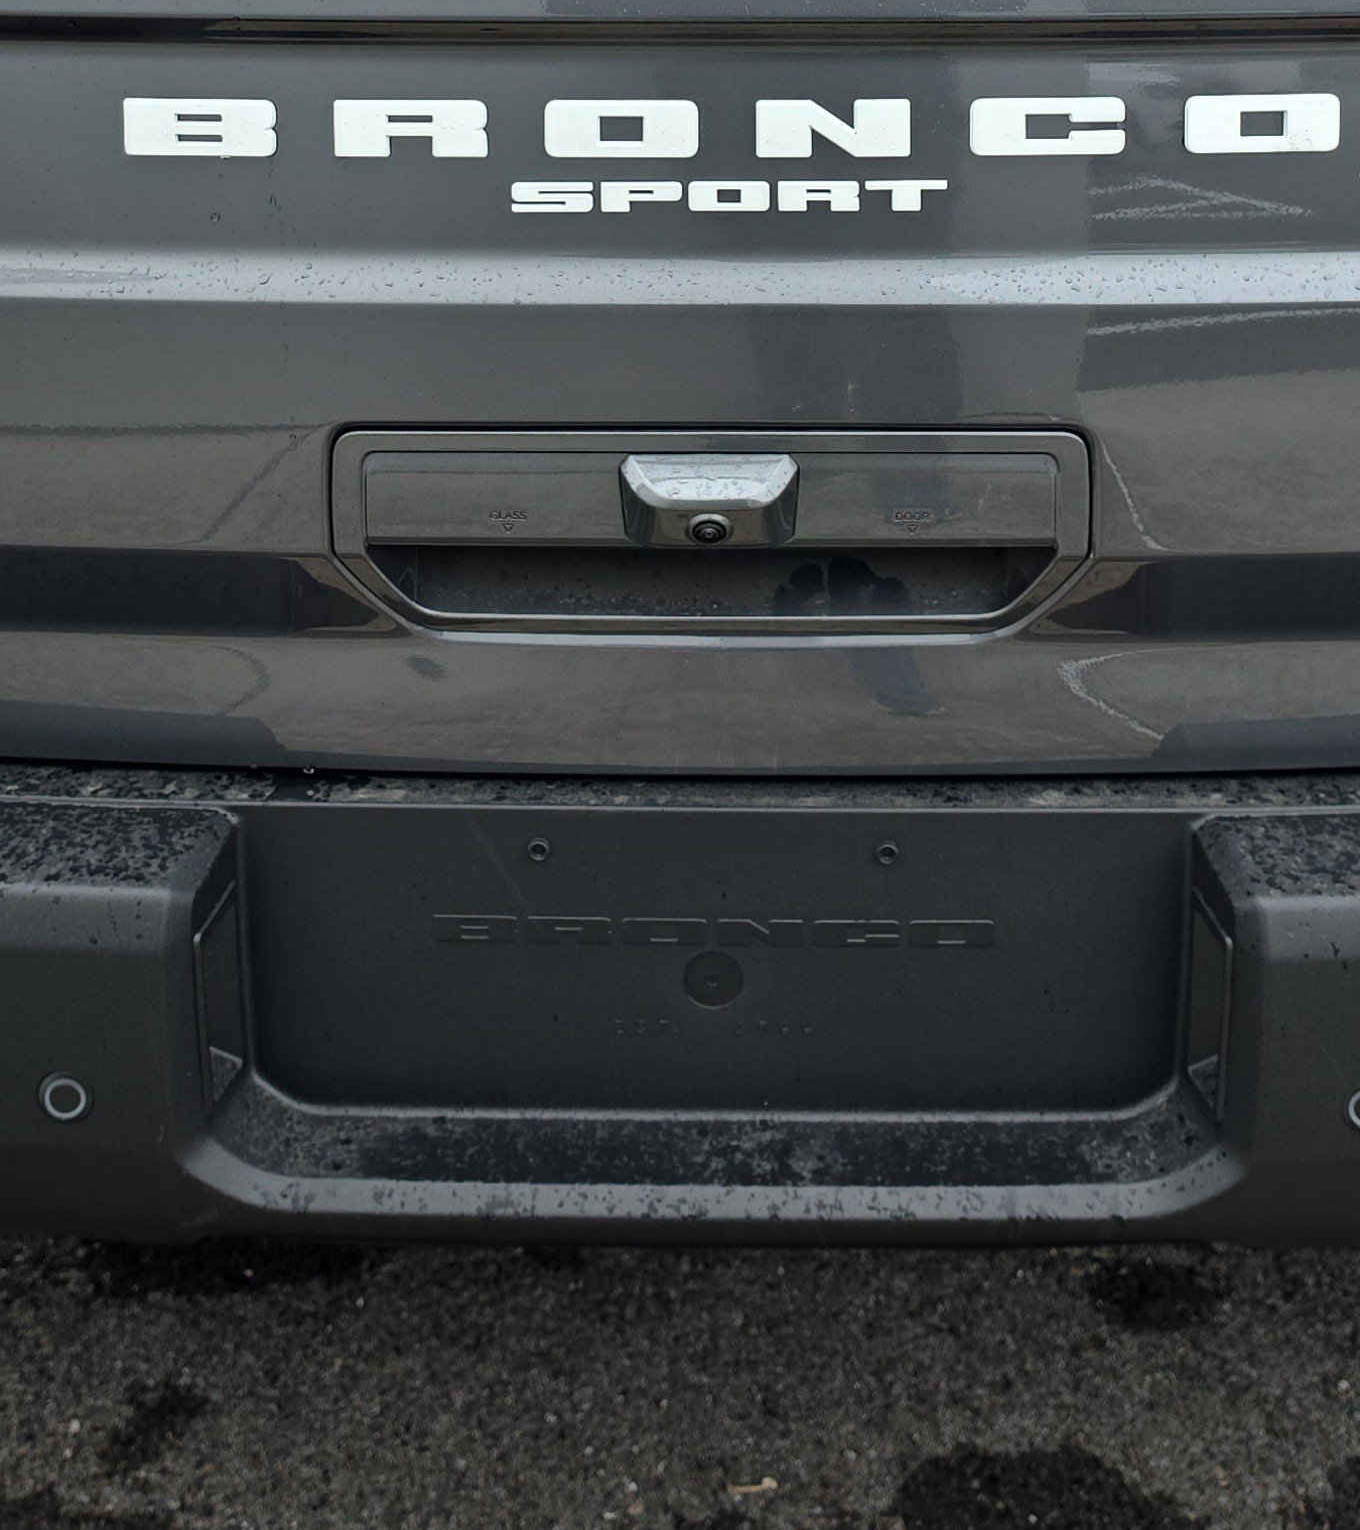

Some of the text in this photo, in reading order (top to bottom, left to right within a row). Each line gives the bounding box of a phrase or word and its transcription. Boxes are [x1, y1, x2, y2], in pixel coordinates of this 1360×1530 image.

[120, 92, 1343, 160] BRONCO
[509, 178, 949, 214] SPORT
[489, 510, 528, 521] GLASS
[895, 511, 930, 522] DOOR
[431, 912, 996, 948] BRONCO
